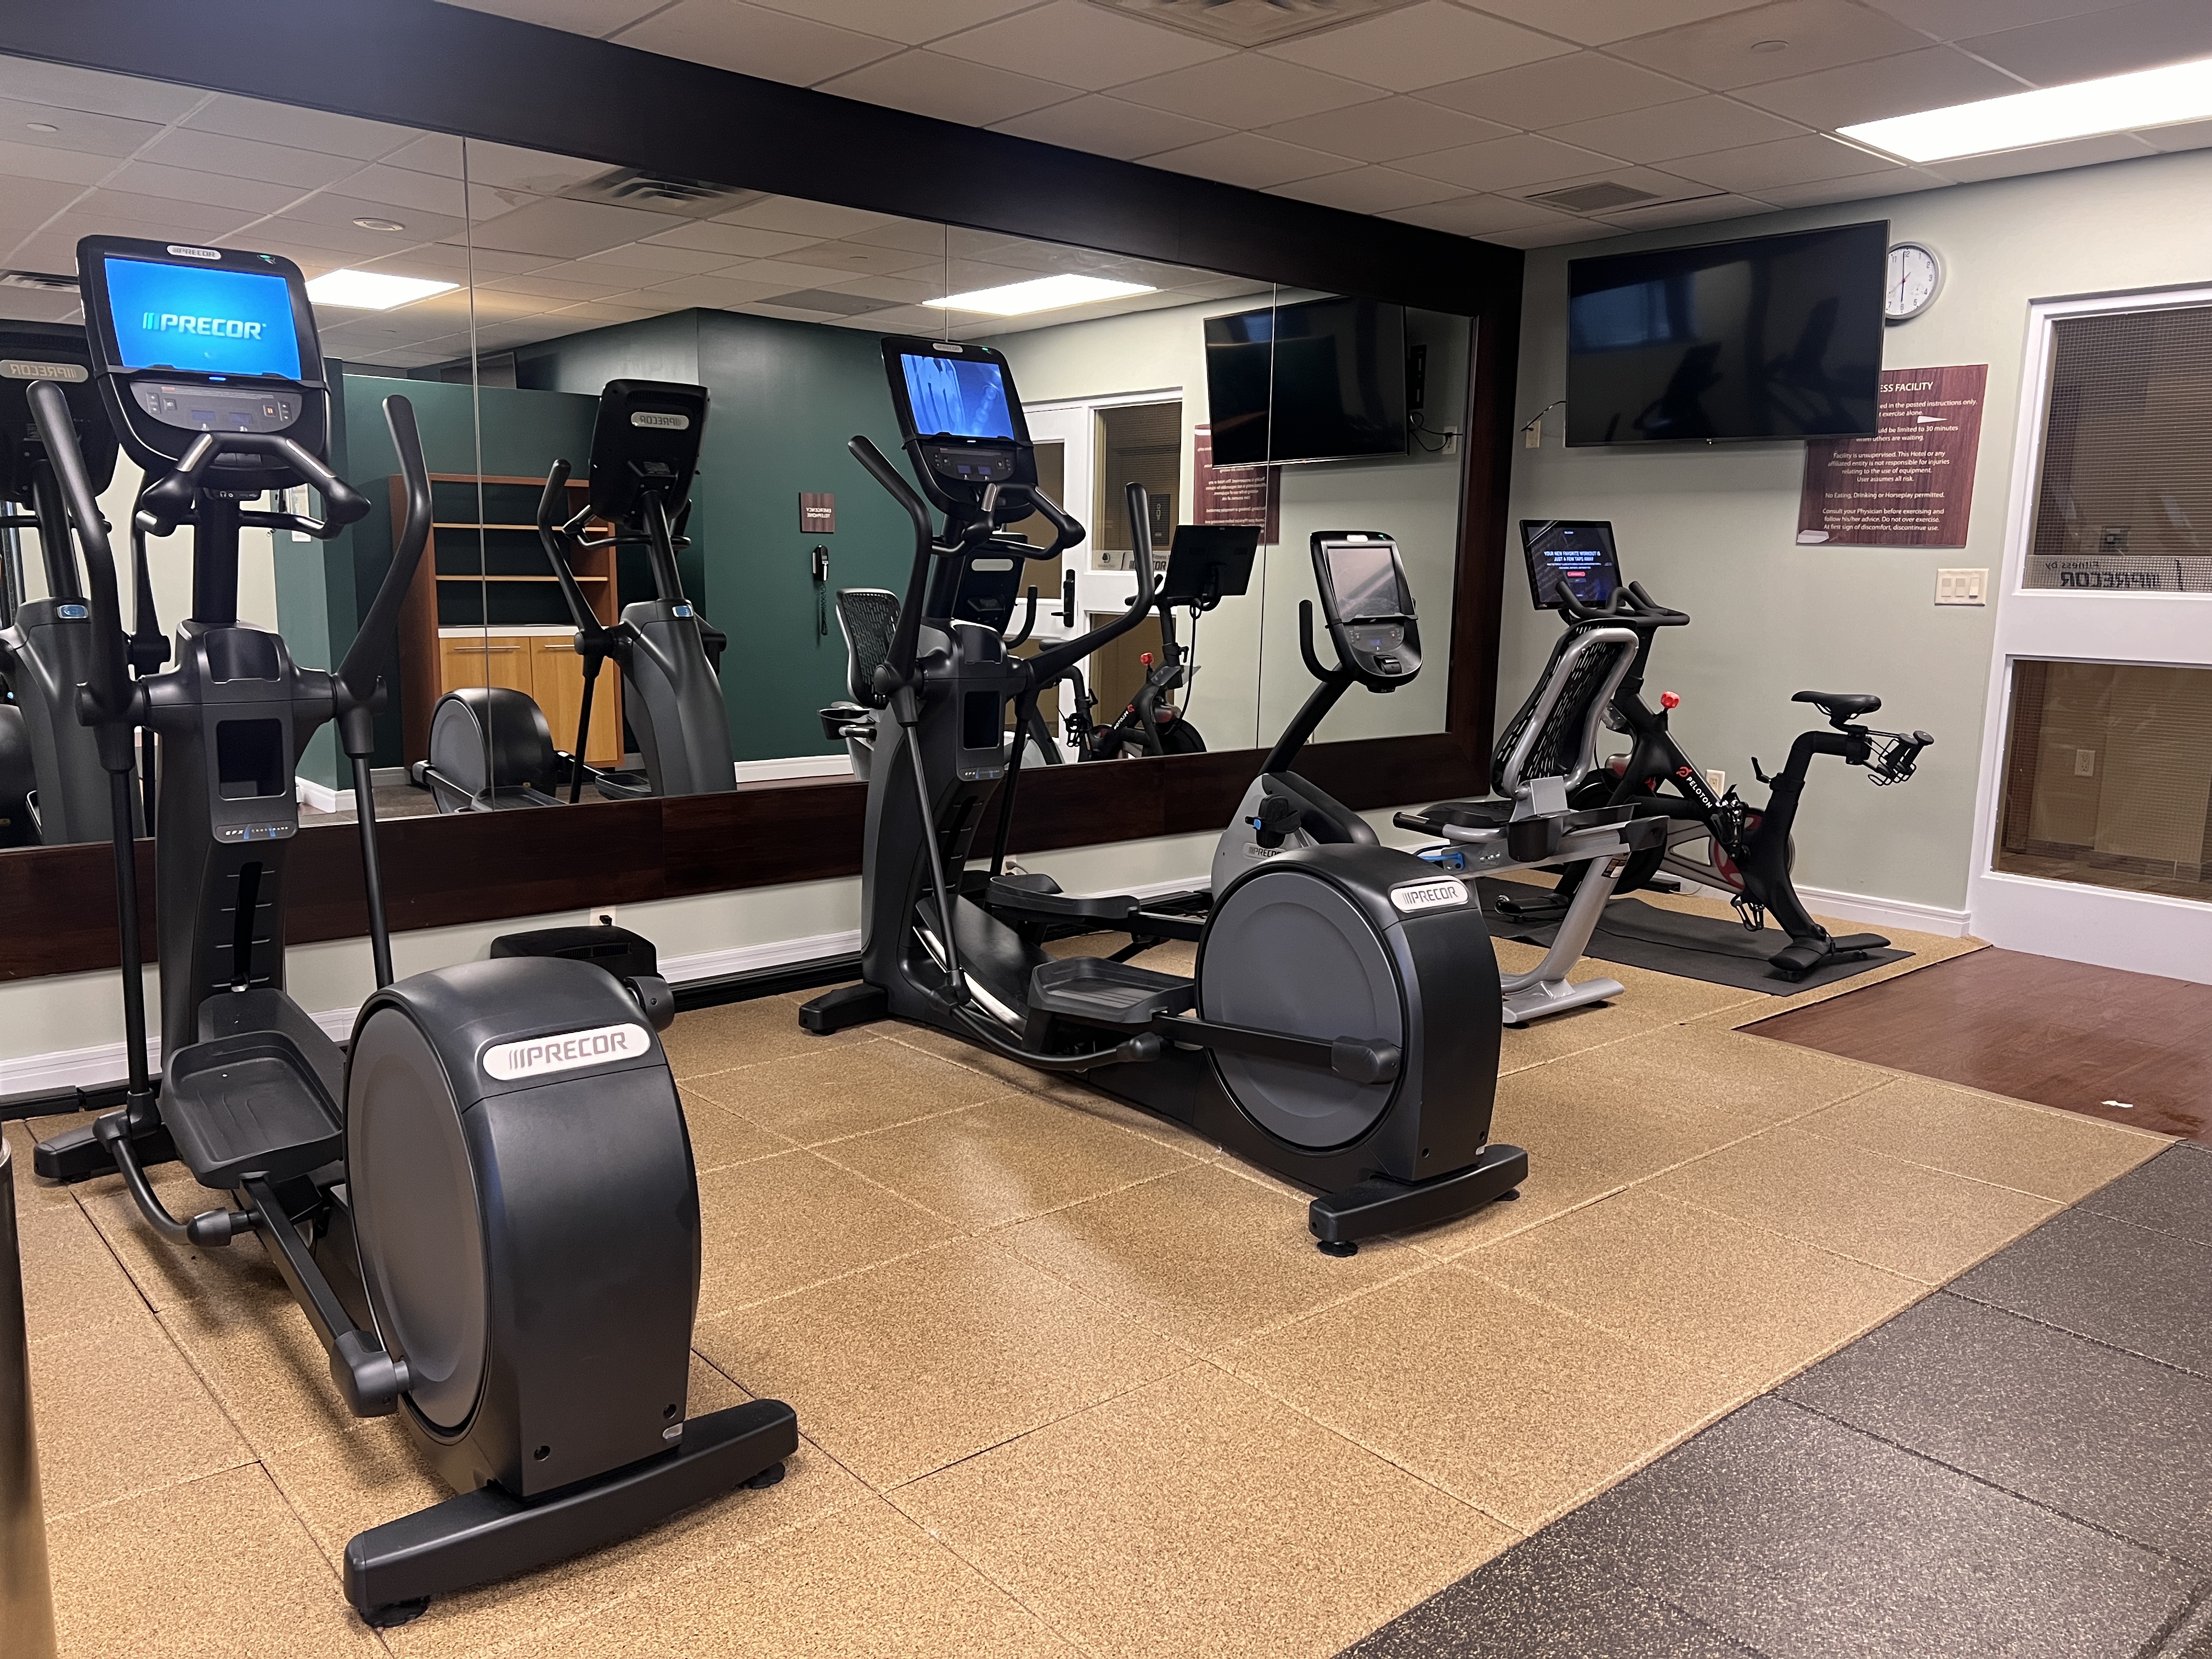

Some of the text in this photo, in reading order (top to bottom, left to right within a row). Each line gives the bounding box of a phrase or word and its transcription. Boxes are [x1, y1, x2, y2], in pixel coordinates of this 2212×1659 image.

[179, 248, 215, 257] PRECOR
[160, 313, 262, 340] PRECOR
[1895, 381, 1934, 392] FACILITY
[1686, 776, 1713, 809] PELOTON
[1253, 847, 1282, 857] PRECO
[1410, 886, 1458, 904] PRECOR
[527, 1032, 628, 1068] PRECOR
